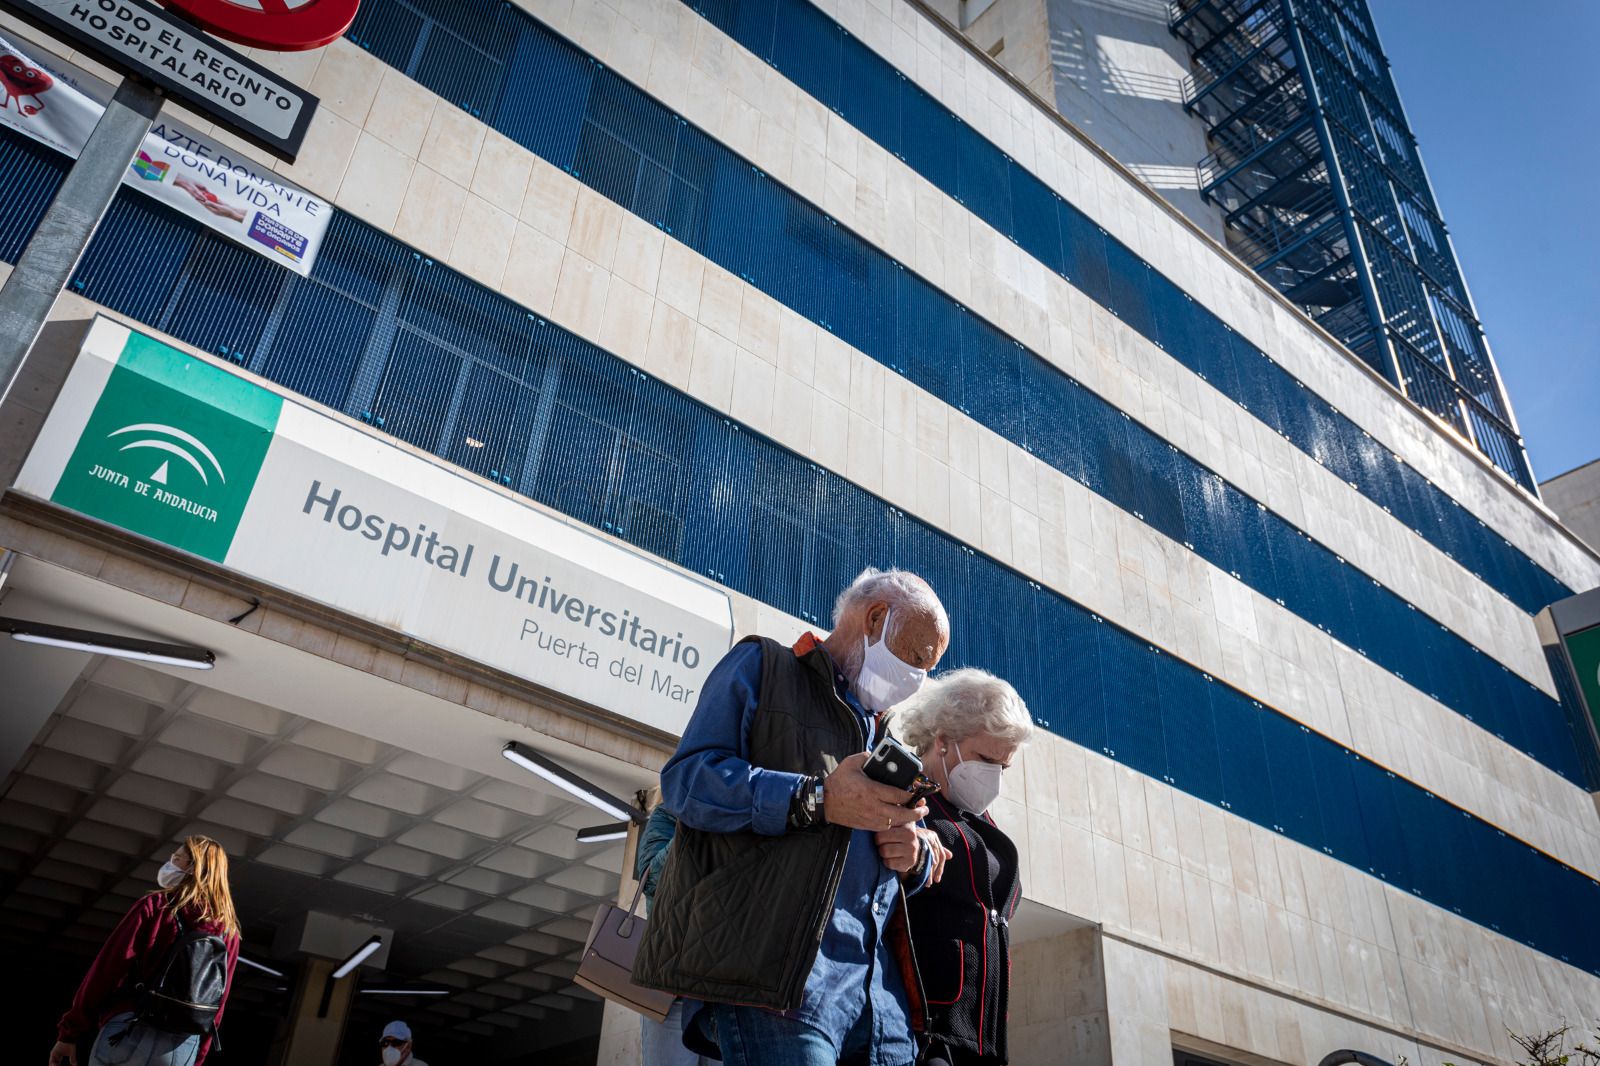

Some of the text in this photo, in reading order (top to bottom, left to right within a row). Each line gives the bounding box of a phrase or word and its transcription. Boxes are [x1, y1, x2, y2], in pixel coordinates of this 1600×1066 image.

[70, 4, 246, 107] HOSPITALARIO
[86, 0, 291, 110] ODO EL RECINTO
[152, 124, 213, 158] AZTE
[164, 146, 280, 216] DONA VIDA
[258, 219, 302, 247] DONANTE
[88, 464, 129, 488] JUNTA
[134, 480, 151, 497] DE
[302, 480, 700, 670] Hospital Universitario
[520, 618, 694, 704] Puerta del Mar
